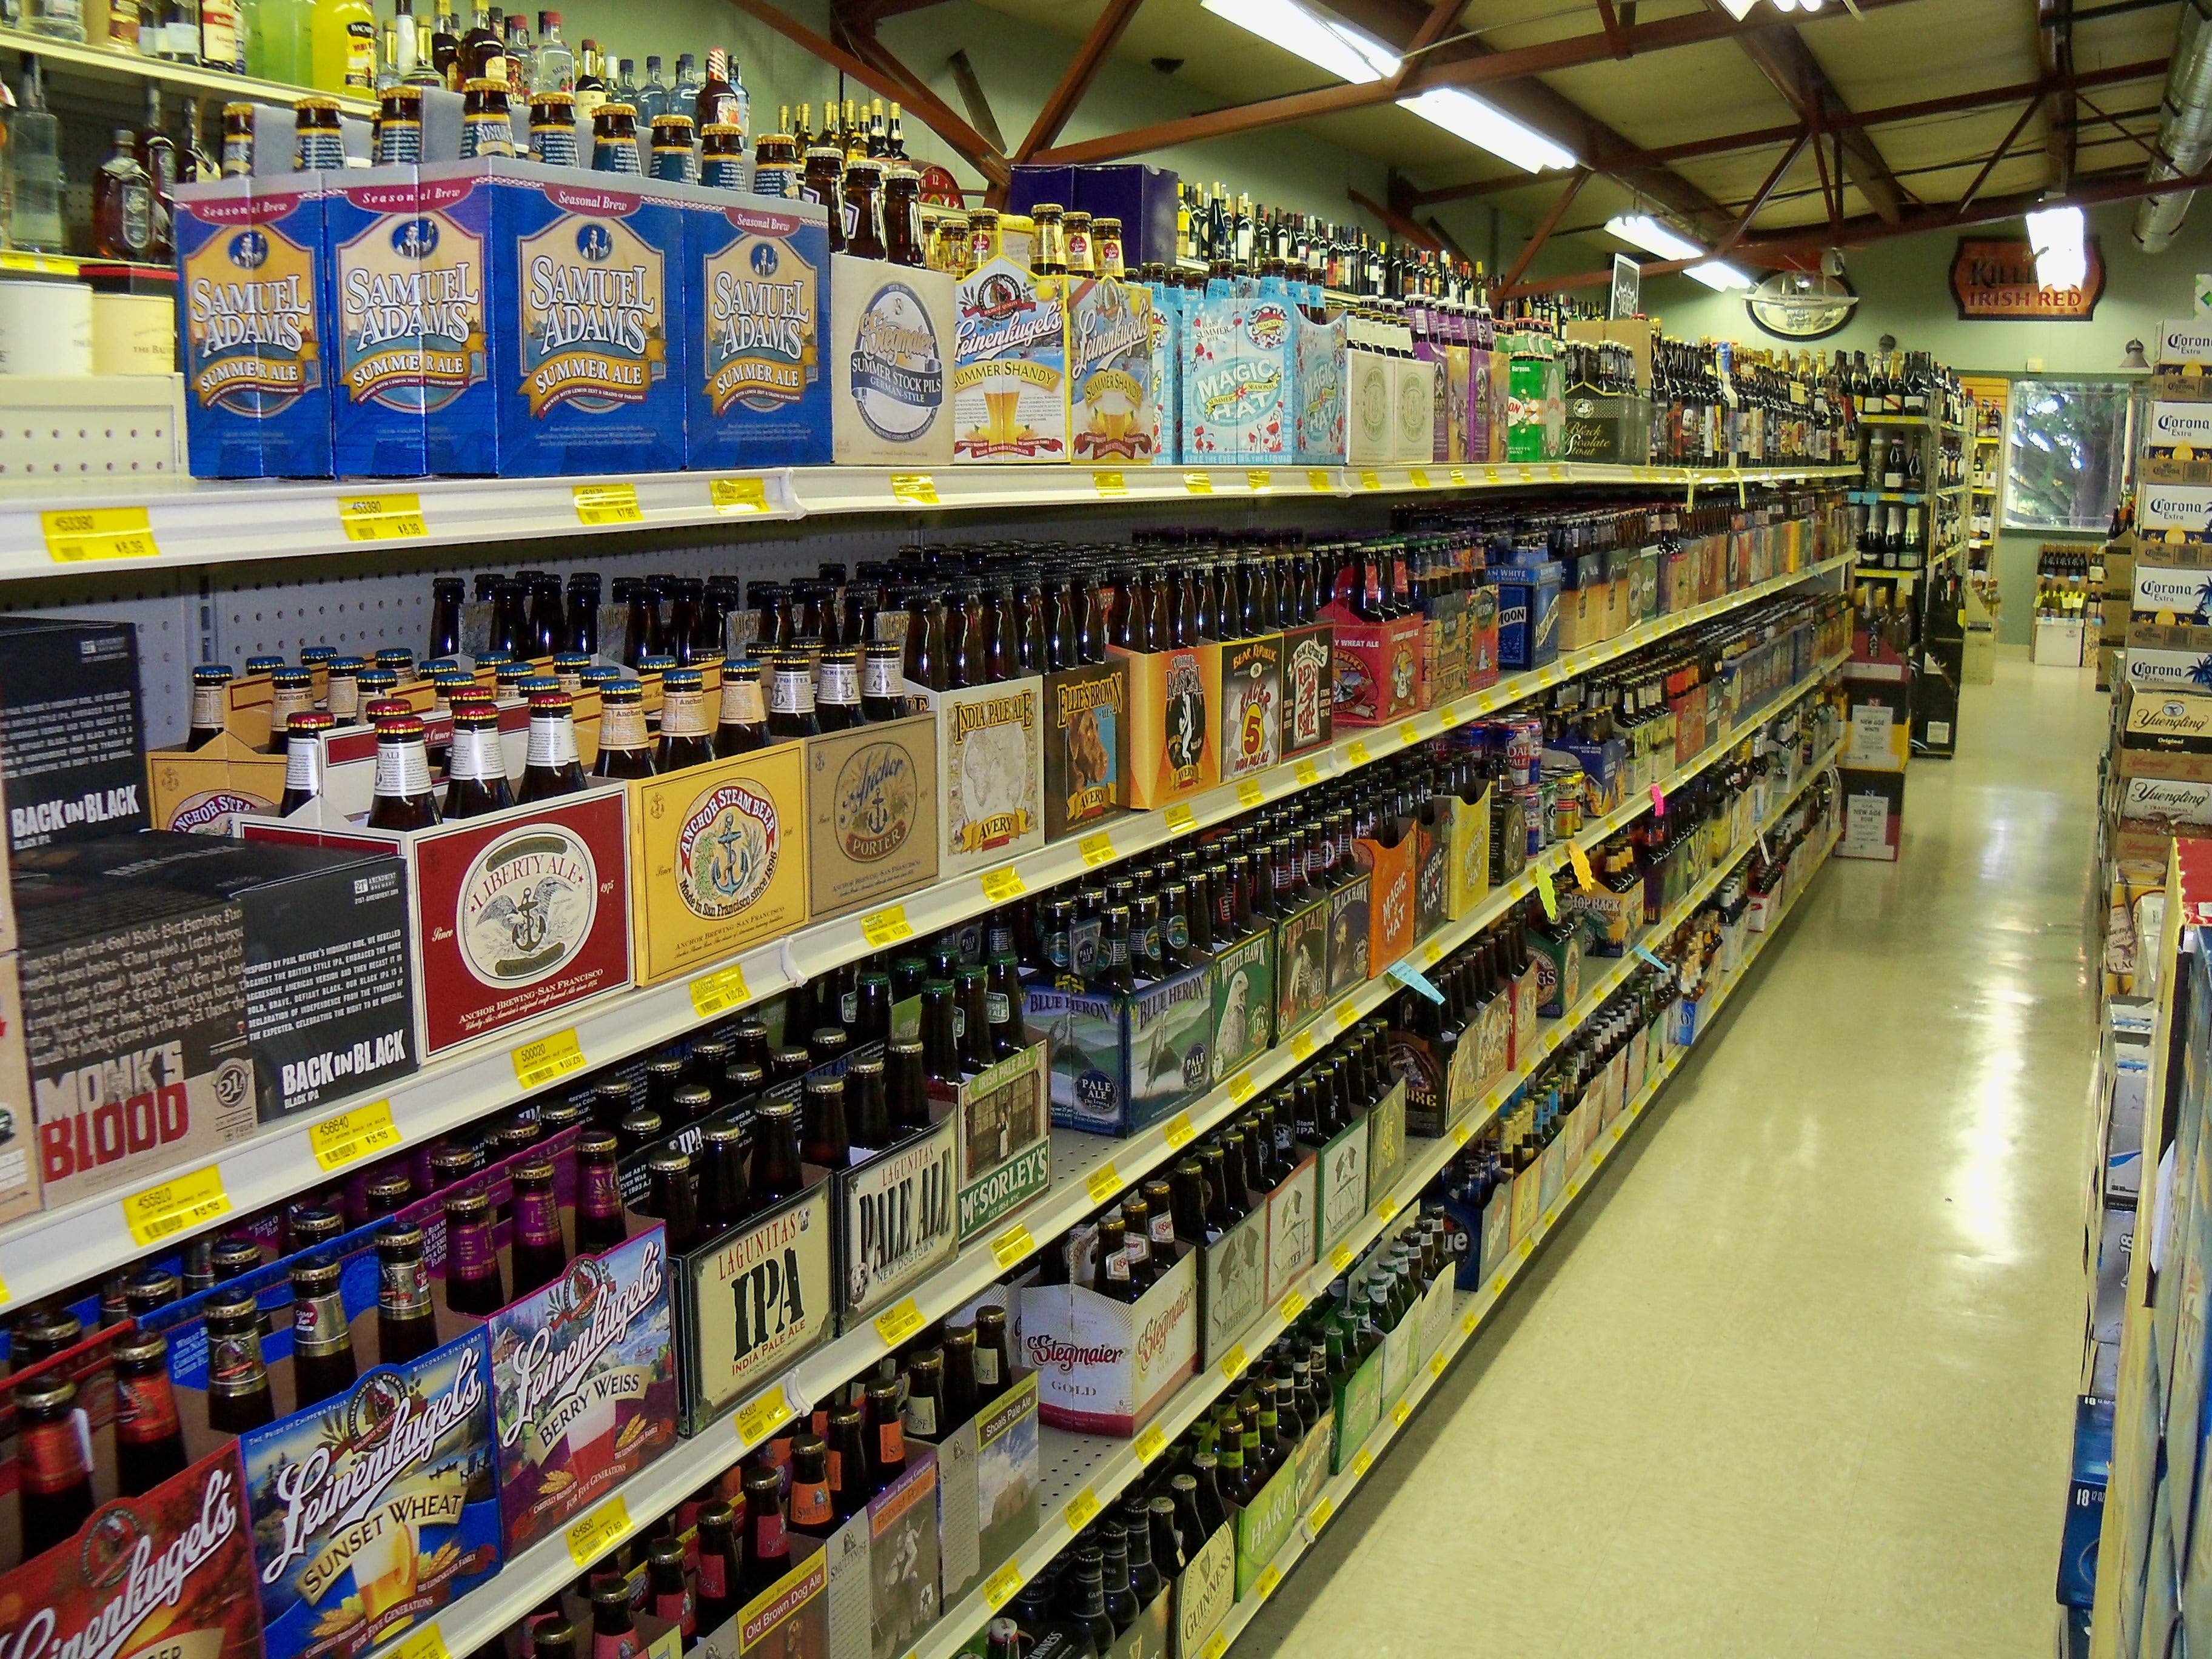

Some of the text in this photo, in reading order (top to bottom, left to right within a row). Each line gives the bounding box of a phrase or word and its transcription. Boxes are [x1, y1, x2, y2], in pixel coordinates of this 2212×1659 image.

[363, 187, 461, 204] Seasonal Brew
[558, 191, 627, 212] Seasonal Brew
[737, 214, 791, 232] Seasonal Brew
[192, 274, 310, 324] SAMUEL
[346, 263, 478, 314] SAMUEL
[530, 255, 655, 313] SAMUEL
[713, 271, 810, 324] SAMUEL
[1970, 292, 2082, 307] IRISH RED
[202, 313, 303, 359] ADAMS
[357, 302, 469, 351] ADAMS
[540, 306, 647, 355] ADAMS
[720, 316, 802, 361] ADAMS
[1072, 298, 1149, 380] Leinenkugel's
[201, 360, 298, 392] SUMMER ALE
[354, 355, 464, 387] SUMMER ALE
[536, 359, 643, 394] SUMMER ALE
[717, 364, 800, 394] SUMMER ALE
[851, 358, 941, 394] SUMMER STOCK PILS
[1004, 361, 1055, 386] SHANDY
[1085, 375, 1113, 398] SUMMER
[1197, 358, 1275, 404] MAGIC
[1213, 391, 1270, 421] HAT
[2158, 414, 2210, 431] Corona
[2171, 429, 2192, 437] Extra
[2150, 497, 2202, 515] Corona
[2163, 512, 2184, 520] Extra
[2140, 579, 2192, 598] Corona
[1233, 645, 1277, 669] BEAR REPUBLIC
[1341, 639, 1365, 648] WHEAT
[1165, 665, 1204, 699] RASCAL
[2131, 660, 2182, 679] Corona
[954, 689, 1033, 745] INDIA PALE ALE
[1057, 672, 1122, 728] ELLIE'S BROWN
[1240, 683, 1271, 719] RACER
[1244, 716, 1262, 755] 5
[2133, 709, 2209, 733] Yuengling
[12, 785, 140, 838] BACK IN BLACK
[1079, 789, 1105, 813] AVERY
[2131, 782, 2209, 808] Yuengling
[681, 788, 776, 859] ANCHOR STEAM BEER
[977, 816, 1014, 842] AVERY
[853, 828, 901, 856] PORTER
[472, 854, 580, 909] LIBERTY ALE
[600, 880, 615, 894] 1975
[679, 878, 695, 911] Made
[703, 904, 717, 917] San
[717, 895, 751, 917] Francisco
[751, 880, 768, 903] since
[764, 851, 778, 879] 1896
[1421, 848, 1443, 899] MAGIC
[1350, 880, 1369, 904] HAWK
[1383, 871, 1407, 926] MAGIC
[1424, 877, 1441, 913] HAT
[432, 927, 454, 942] Since
[1386, 902, 1406, 942] HAT
[1221, 936, 1265, 989] WHITE HAWK
[1030, 993, 1110, 1024] BLUE HERON
[1139, 976, 1205, 1031] BLUE HERON
[282, 1028, 406, 1096] BACK IN BLACK
[521, 1044, 546, 1062] 500020
[1185, 1051, 1205, 1071] PALE
[35, 1040, 184, 1124] MONK'S
[978, 1051, 1031, 1092] IRISH PALE ALE
[1082, 1078, 1112, 1092] PALE
[1189, 1065, 1202, 1079] ALE
[284, 1089, 320, 1110] BLACK IPA
[1087, 1090, 1107, 1100] ALE
[39, 1082, 190, 1183] BLOOD
[1296, 1119, 1315, 1128] Stone
[1296, 1126, 1315, 1135] IPA
[882, 1142, 934, 1187] LAGUNITAS
[718, 1212, 797, 1282] LAGUNITAS
[877, 1239, 935, 1284] NEW DOGTOWN
[731, 1246, 805, 1362] IPA
[502, 1239, 662, 1449] Leinenkugel's
[732, 1318, 806, 1376] INDIA PALE ALE
[1027, 1334, 1124, 1373] Stegmaier
[1051, 1380, 1097, 1396] GOLD
[539, 1373, 640, 1449] BERRY WEISS
[986, 1395, 1031, 1437] Shoals Pale Ale
[262, 1347, 484, 1584] Leinenkugel's
[566, 1463, 626, 1512] FOR FIVE GENERATIONS
[2076, 1489, 2090, 1507] 18
[1250, 1481, 1291, 1554] HARP
[304, 1494, 463, 1597] SUNSET WHEAT
[384, 1595, 434, 1624] GENERATIONS
[745, 1572, 823, 1640] Old Brown Dog Ale
[1184, 1547, 1232, 1641] GUINNESS
